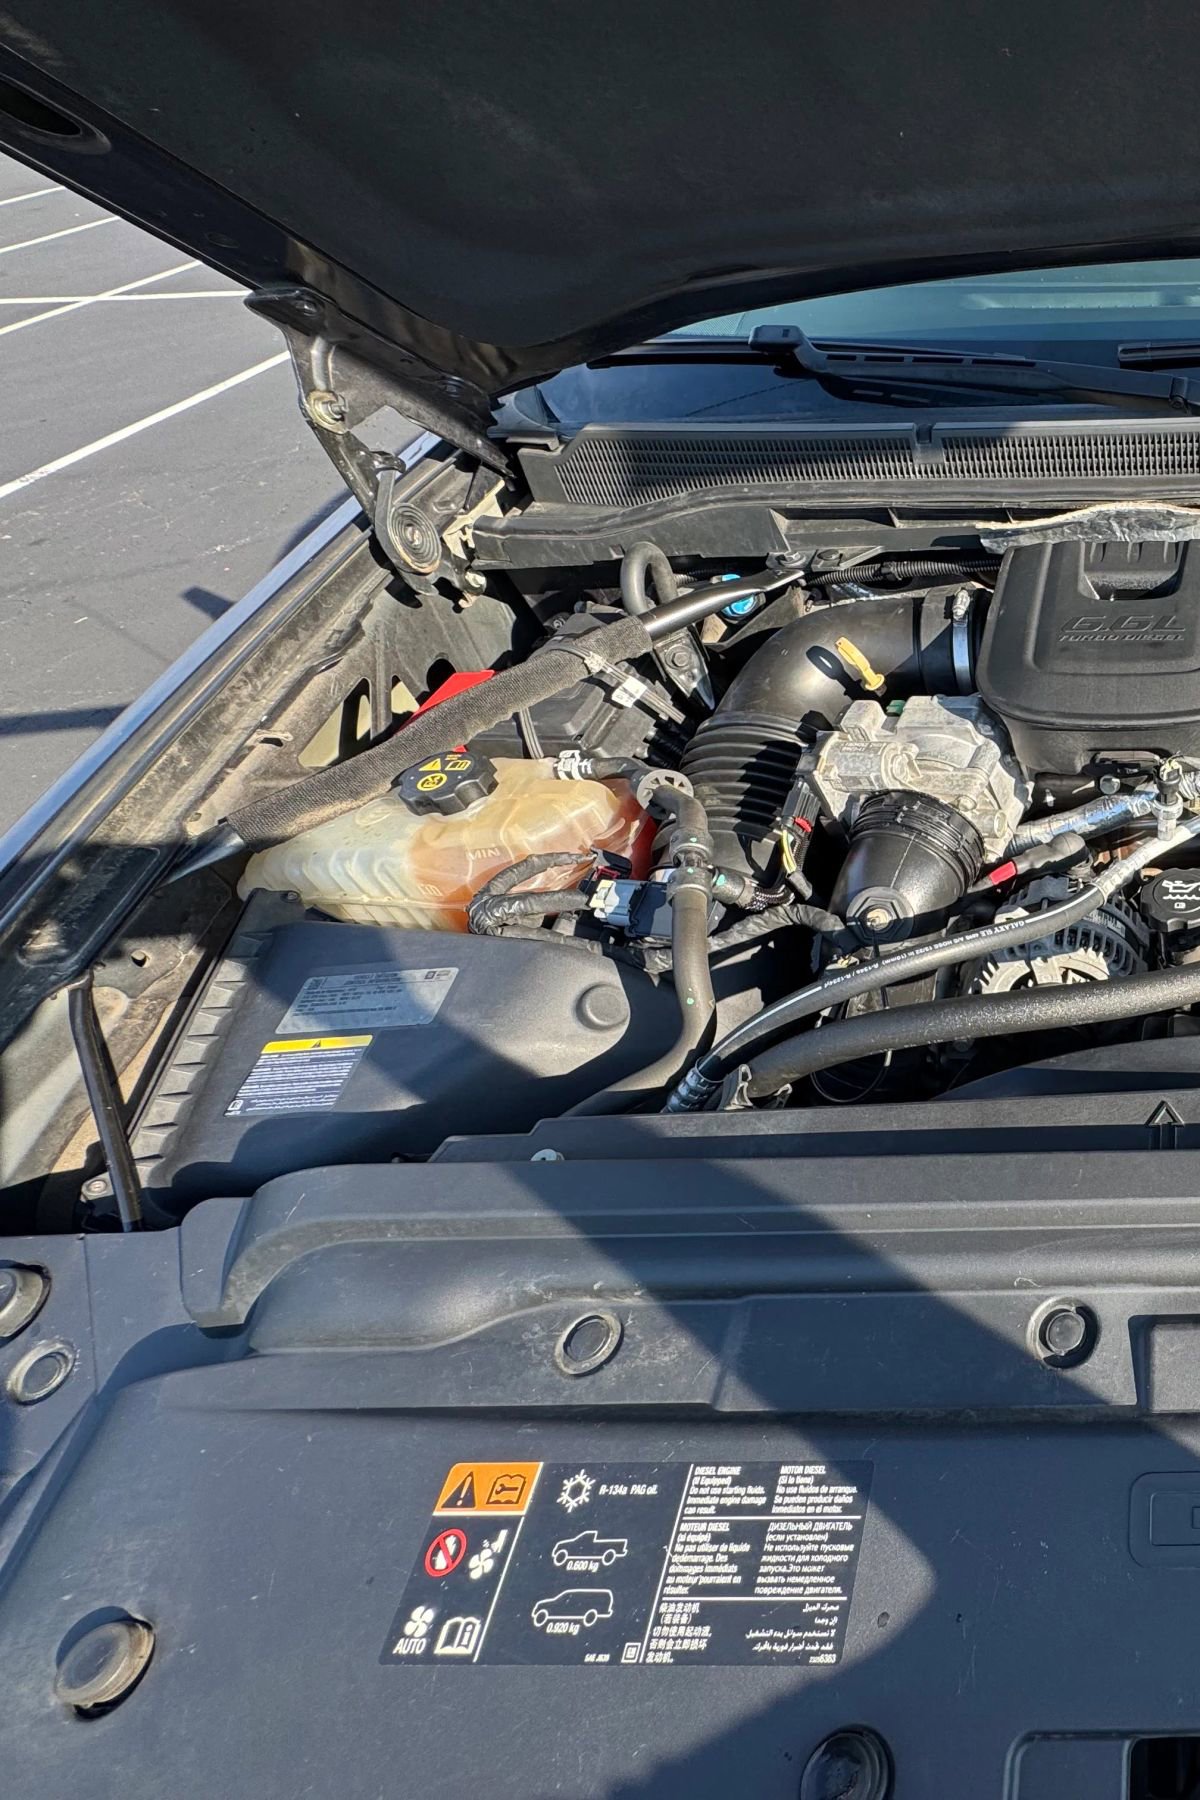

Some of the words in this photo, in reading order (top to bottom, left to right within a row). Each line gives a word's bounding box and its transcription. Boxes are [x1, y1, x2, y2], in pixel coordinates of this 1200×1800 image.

[1060, 615, 1186, 632] 6.6L
[466, 847, 500, 860] MIN
[994, 920, 1025, 933] GALAXY
[694, 1466, 717, 1476] DIESEL
[718, 1466, 742, 1475] ENGINE
[780, 1465, 804, 1474] MOTOR
[804, 1465, 826, 1474] DIESEL
[700, 1476, 732, 1486] Equipped)
[778, 1476, 788, 1485] (Si
[795, 1476, 814, 1485] tiene)
[598, 1484, 628, 1495] R-134a
[630, 1484, 646, 1495] PAG
[646, 1484, 658, 1495] oil.
[690, 1486, 698, 1494] Do
[699, 1486, 709, 1494] not
[722, 1486, 746, 1496] starting
[776, 1486, 786, 1494] No
[798, 1486, 819, 1494] fluidos
[820, 1486, 828, 1494] de
[686, 1496, 720, 1504] Immediate
[720, 1496, 740, 1506] engine
[741, 1496, 767, 1506] damage
[774, 1495, 782, 1504] Se
[782, 1495, 806, 1505] pueden
[807, 1495, 834, 1505] producir
[834, 1494, 854, 1504] daños
[684, 1506, 697, 1514] can
[697, 1506, 716, 1514] result.
[822, 1505, 842, 1514] motor.
[680, 1522, 708, 1532] MOTEUR
[708, 1522, 730, 1532] DIESEL
[768, 1521, 812, 1532] ДИЗЕЛЬНЫЙ
[812, 1522, 853, 1532] ДВИГАТЕЛЬ
[676, 1532, 686, 1543] (si
[686, 1532, 712, 1543] équipé)
[766, 1532, 786, 1543] (если
[786, 1532, 828, 1543] установлен)
[674, 1544, 684, 1552] Ne
[684, 1544, 696, 1554] pas
[696, 1543, 719, 1552] utiliser
[719, 1543, 728, 1552] de
[728, 1542, 750, 1554] liquide
[764, 1543, 774, 1552] Не
[774, 1542, 818, 1553] используйте
[820, 1544, 854, 1553] пусковые
[715, 1553, 728, 1562] Des
[760, 1554, 796, 1562] жидкости
[796, 1554, 810, 1563] для
[810, 1554, 848, 1562] холодного
[566, 1560, 588, 1570] 0.600
[589, 1560, 600, 1574] kg
[668, 1564, 704, 1574] dommages
[704, 1564, 738, 1572] immédiats
[666, 1576, 676, 1584] au
[676, 1575, 698, 1584] moteur
[698, 1574, 732, 1585] pourraient
[732, 1576, 742, 1584] en
[756, 1576, 786, 1584] вызвать
[786, 1576, 836, 1584] немедленное
[663, 1586, 689, 1594] résulter.
[754, 1586, 804, 1596] повреждение
[804, 1586, 842, 1595] двигателя.
[546, 1622, 568, 1633] 0.920
[568, 1622, 580, 1636] kg
[392, 1638, 426, 1654] AUTO
